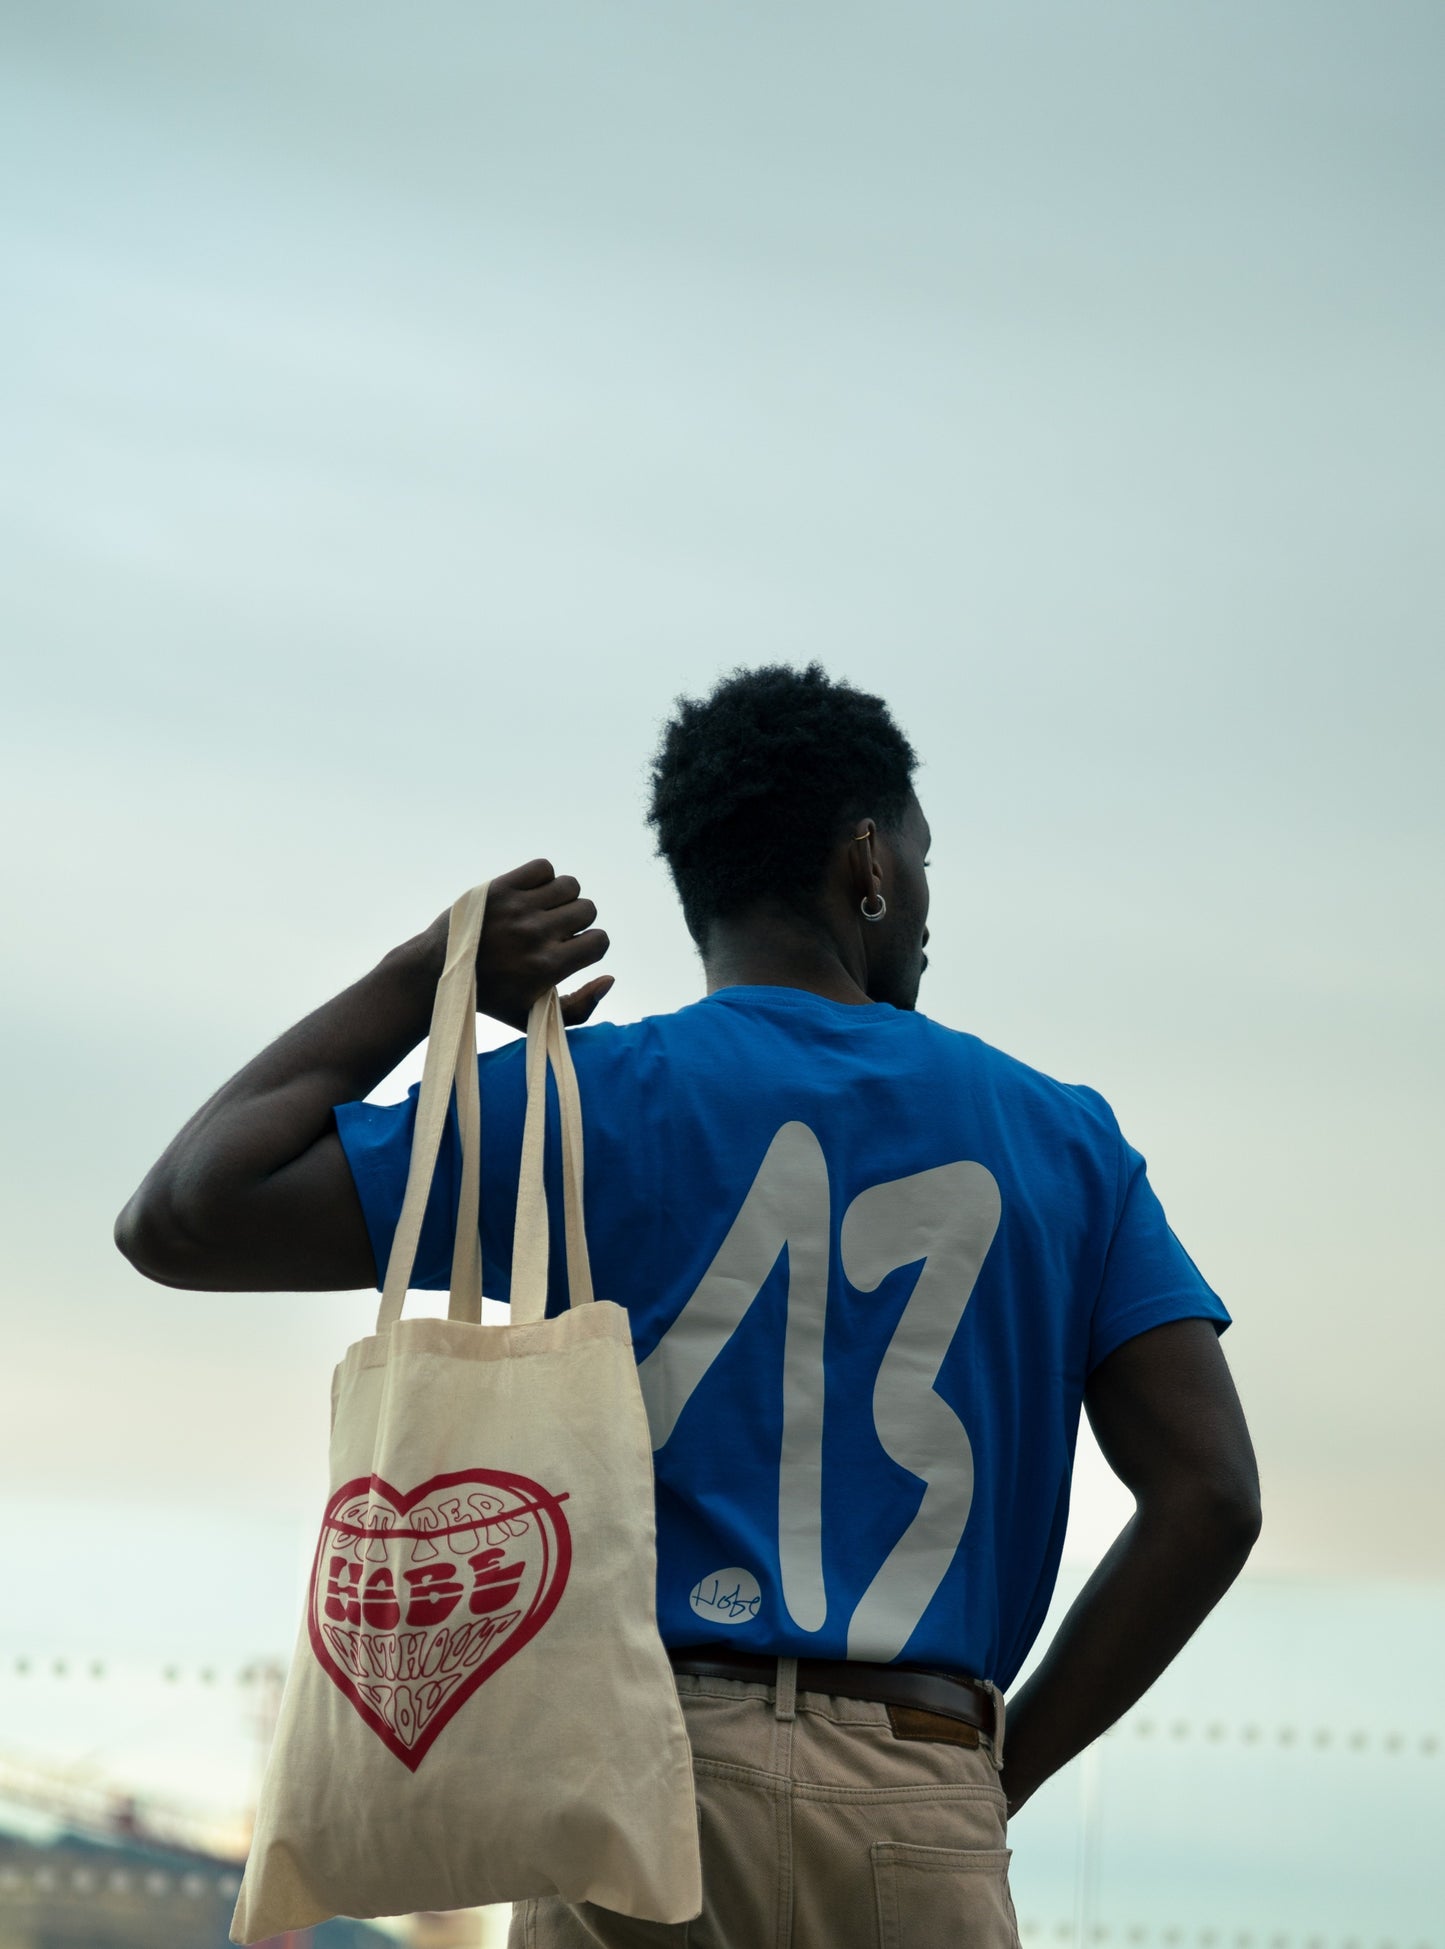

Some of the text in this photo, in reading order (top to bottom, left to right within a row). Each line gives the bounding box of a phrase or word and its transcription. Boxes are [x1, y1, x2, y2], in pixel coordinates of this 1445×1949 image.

[324, 1548, 526, 1631] HOBE
[323, 1610, 521, 1681] WITHOUT
[357, 1674, 462, 1746] YOU
